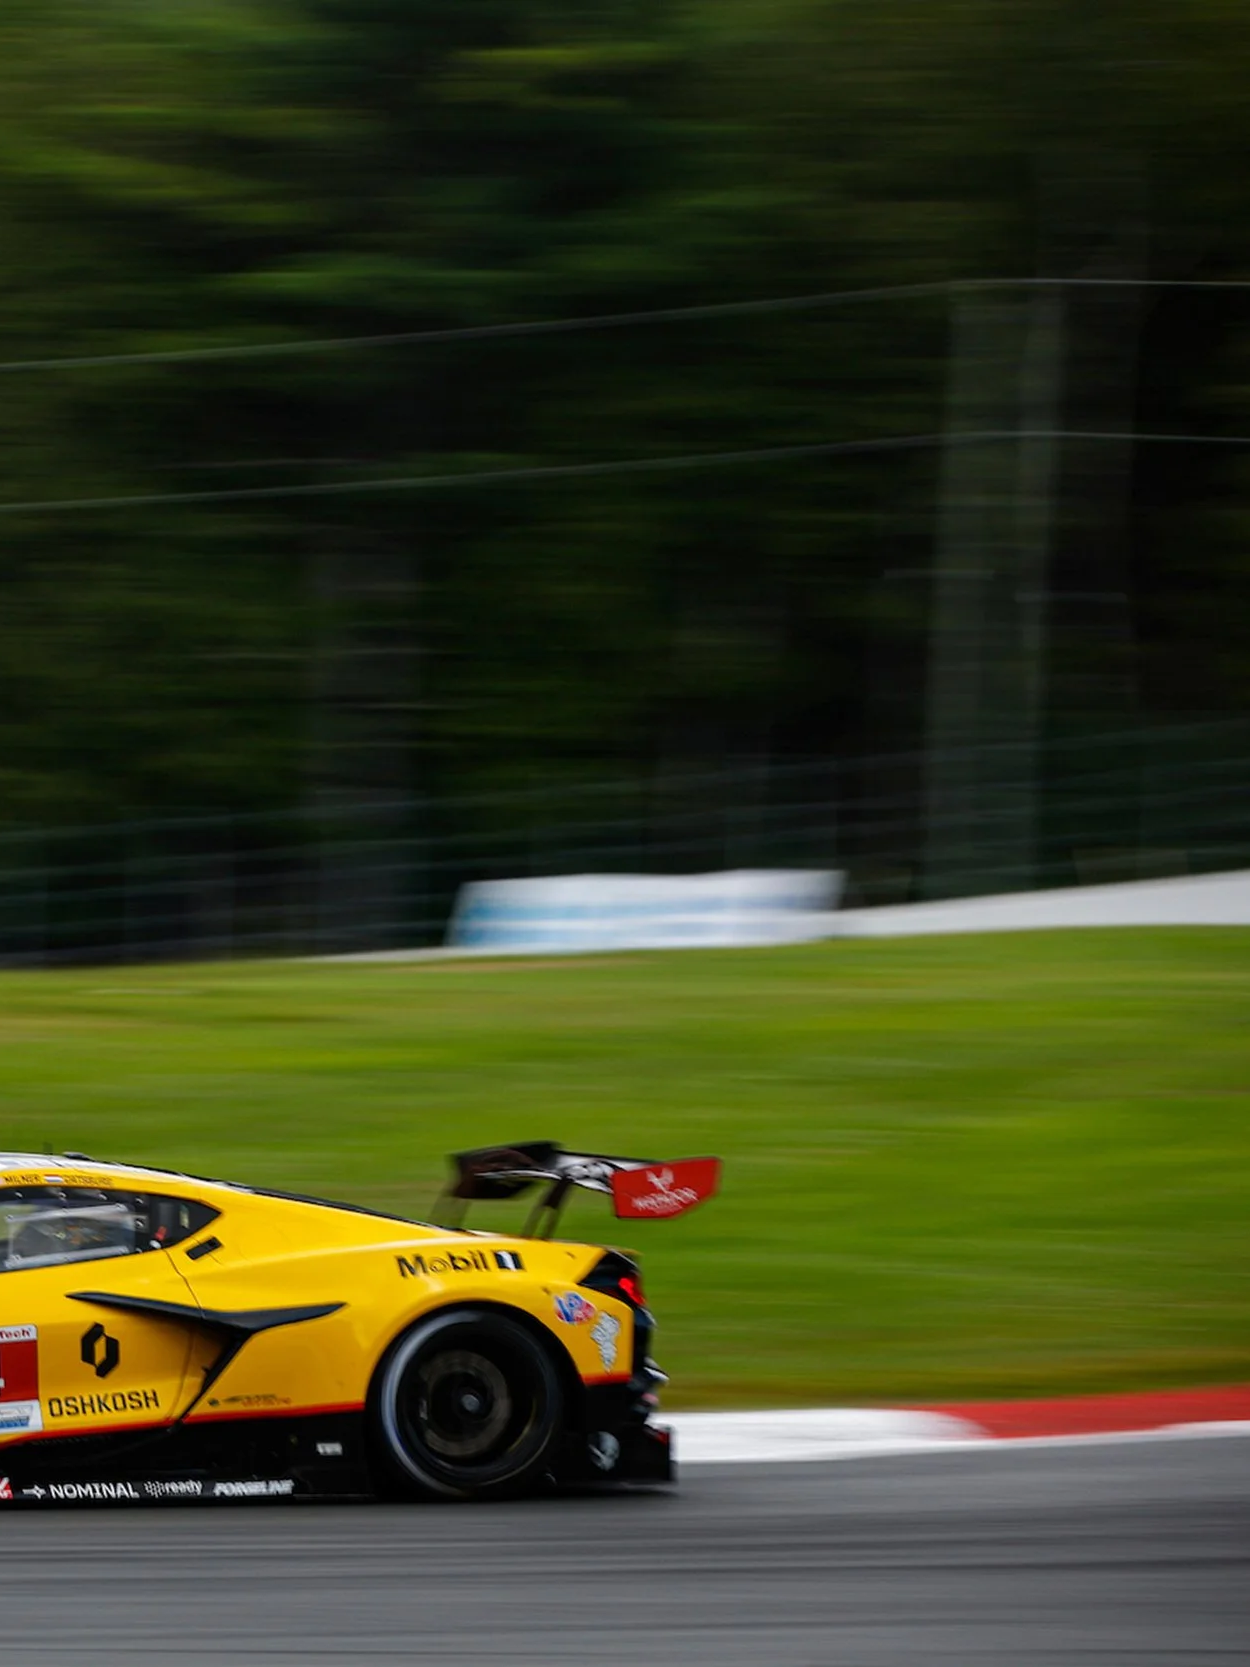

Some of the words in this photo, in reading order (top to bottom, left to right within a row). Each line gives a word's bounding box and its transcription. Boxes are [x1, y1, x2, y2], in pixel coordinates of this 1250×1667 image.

[394, 1249, 491, 1279] Mobil
[48, 1392, 160, 1418] OSHKOSH
[49, 1481, 140, 1499] NOMINAL
